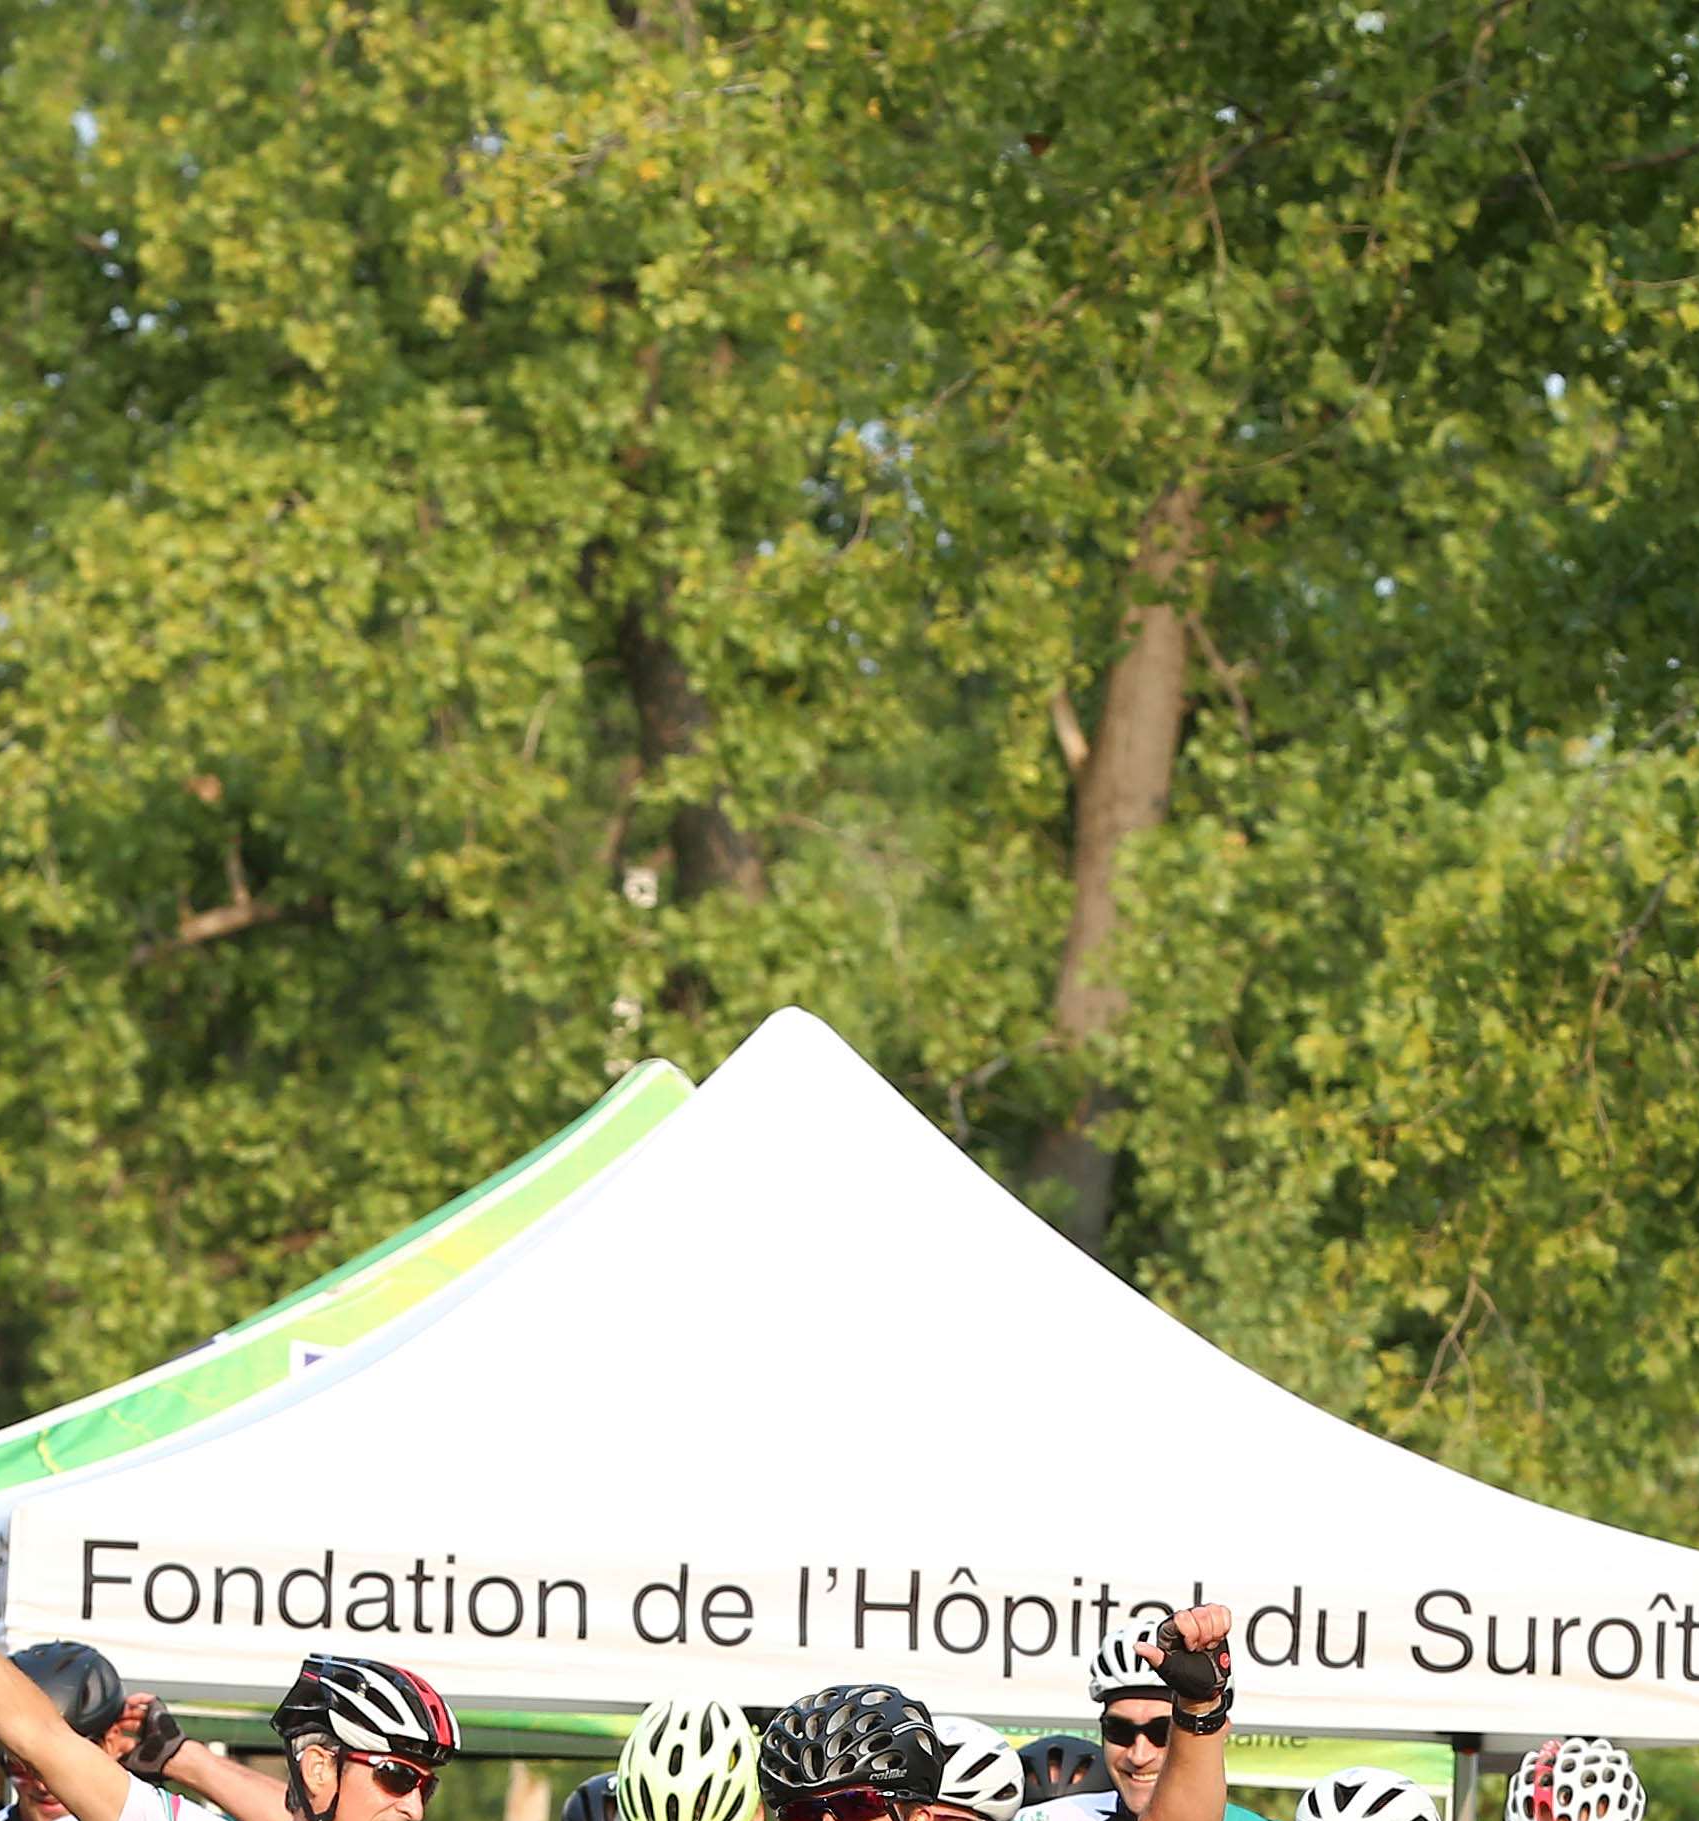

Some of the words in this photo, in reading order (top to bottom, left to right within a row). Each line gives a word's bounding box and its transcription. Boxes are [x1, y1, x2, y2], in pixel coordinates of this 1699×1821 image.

[80, 1538, 588, 1640] Fondation
[631, 1563, 754, 1647] de
[1246, 1587, 1368, 1670] du
